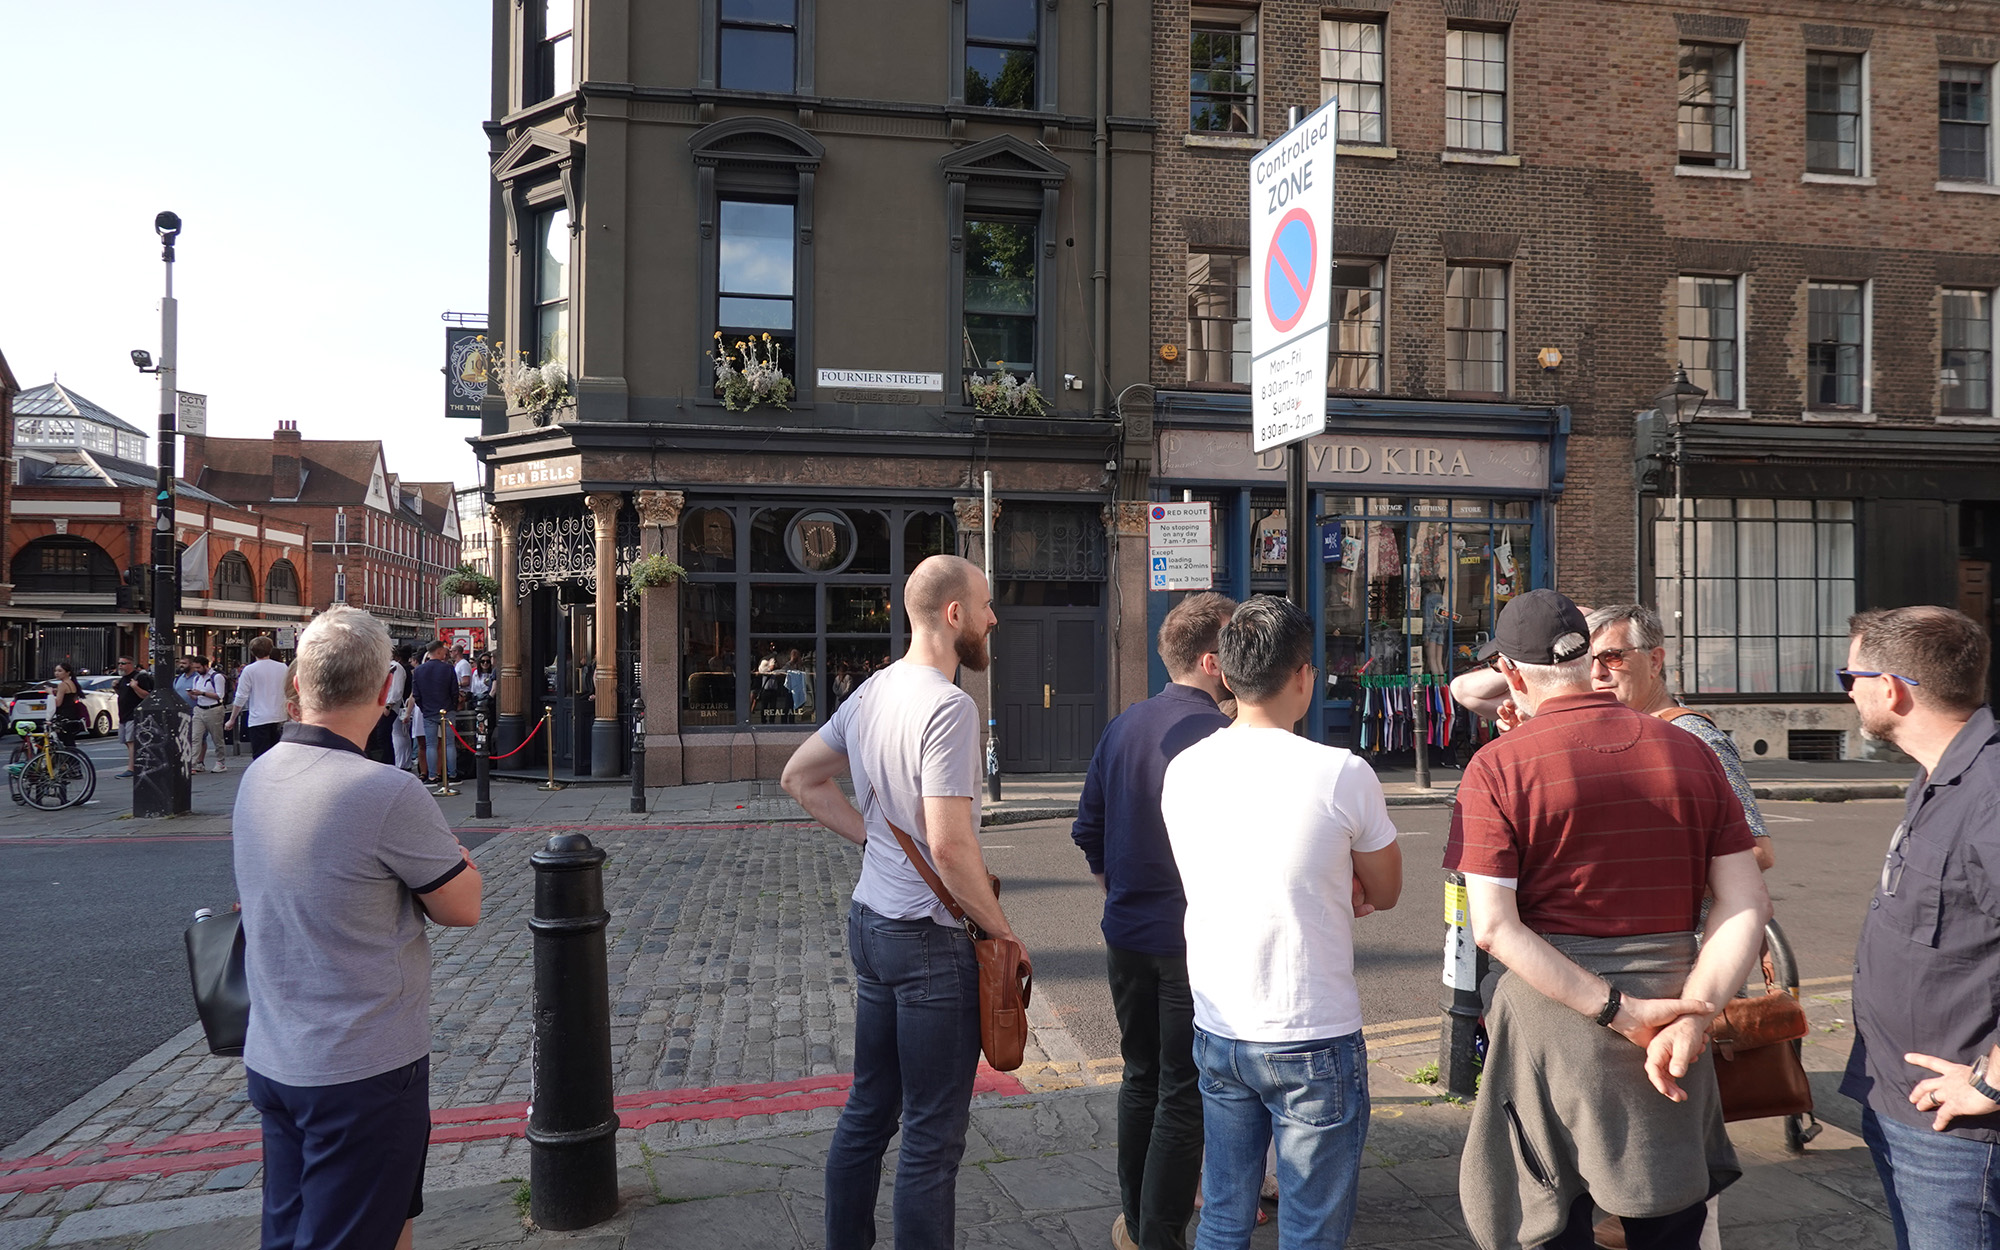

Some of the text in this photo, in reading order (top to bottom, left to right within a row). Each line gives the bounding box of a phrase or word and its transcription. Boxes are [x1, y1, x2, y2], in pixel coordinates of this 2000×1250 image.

[1257, 114, 1328, 184] Controlled
[1268, 159, 1313, 215] ZONE
[1269, 360, 1286, 375] Mon
[1291, 348, 1302, 366] Fri
[821, 371, 883, 383] FOURNIER
[885, 374, 930, 385] STREET
[180, 395, 205, 406] CCTV
[1273, 396, 1300, 416] Sunday
[528, 460, 547, 470] THE
[1256, 444, 1474, 477] DVID KIRA
[500, 466, 574, 486] TEN BELLS
[1171, 524, 1200, 532] stopping
[690, 702, 729, 710] UPSTAIRS
[764, 707, 804, 716] REAL ALE
[701, 710, 718, 718] BAR
